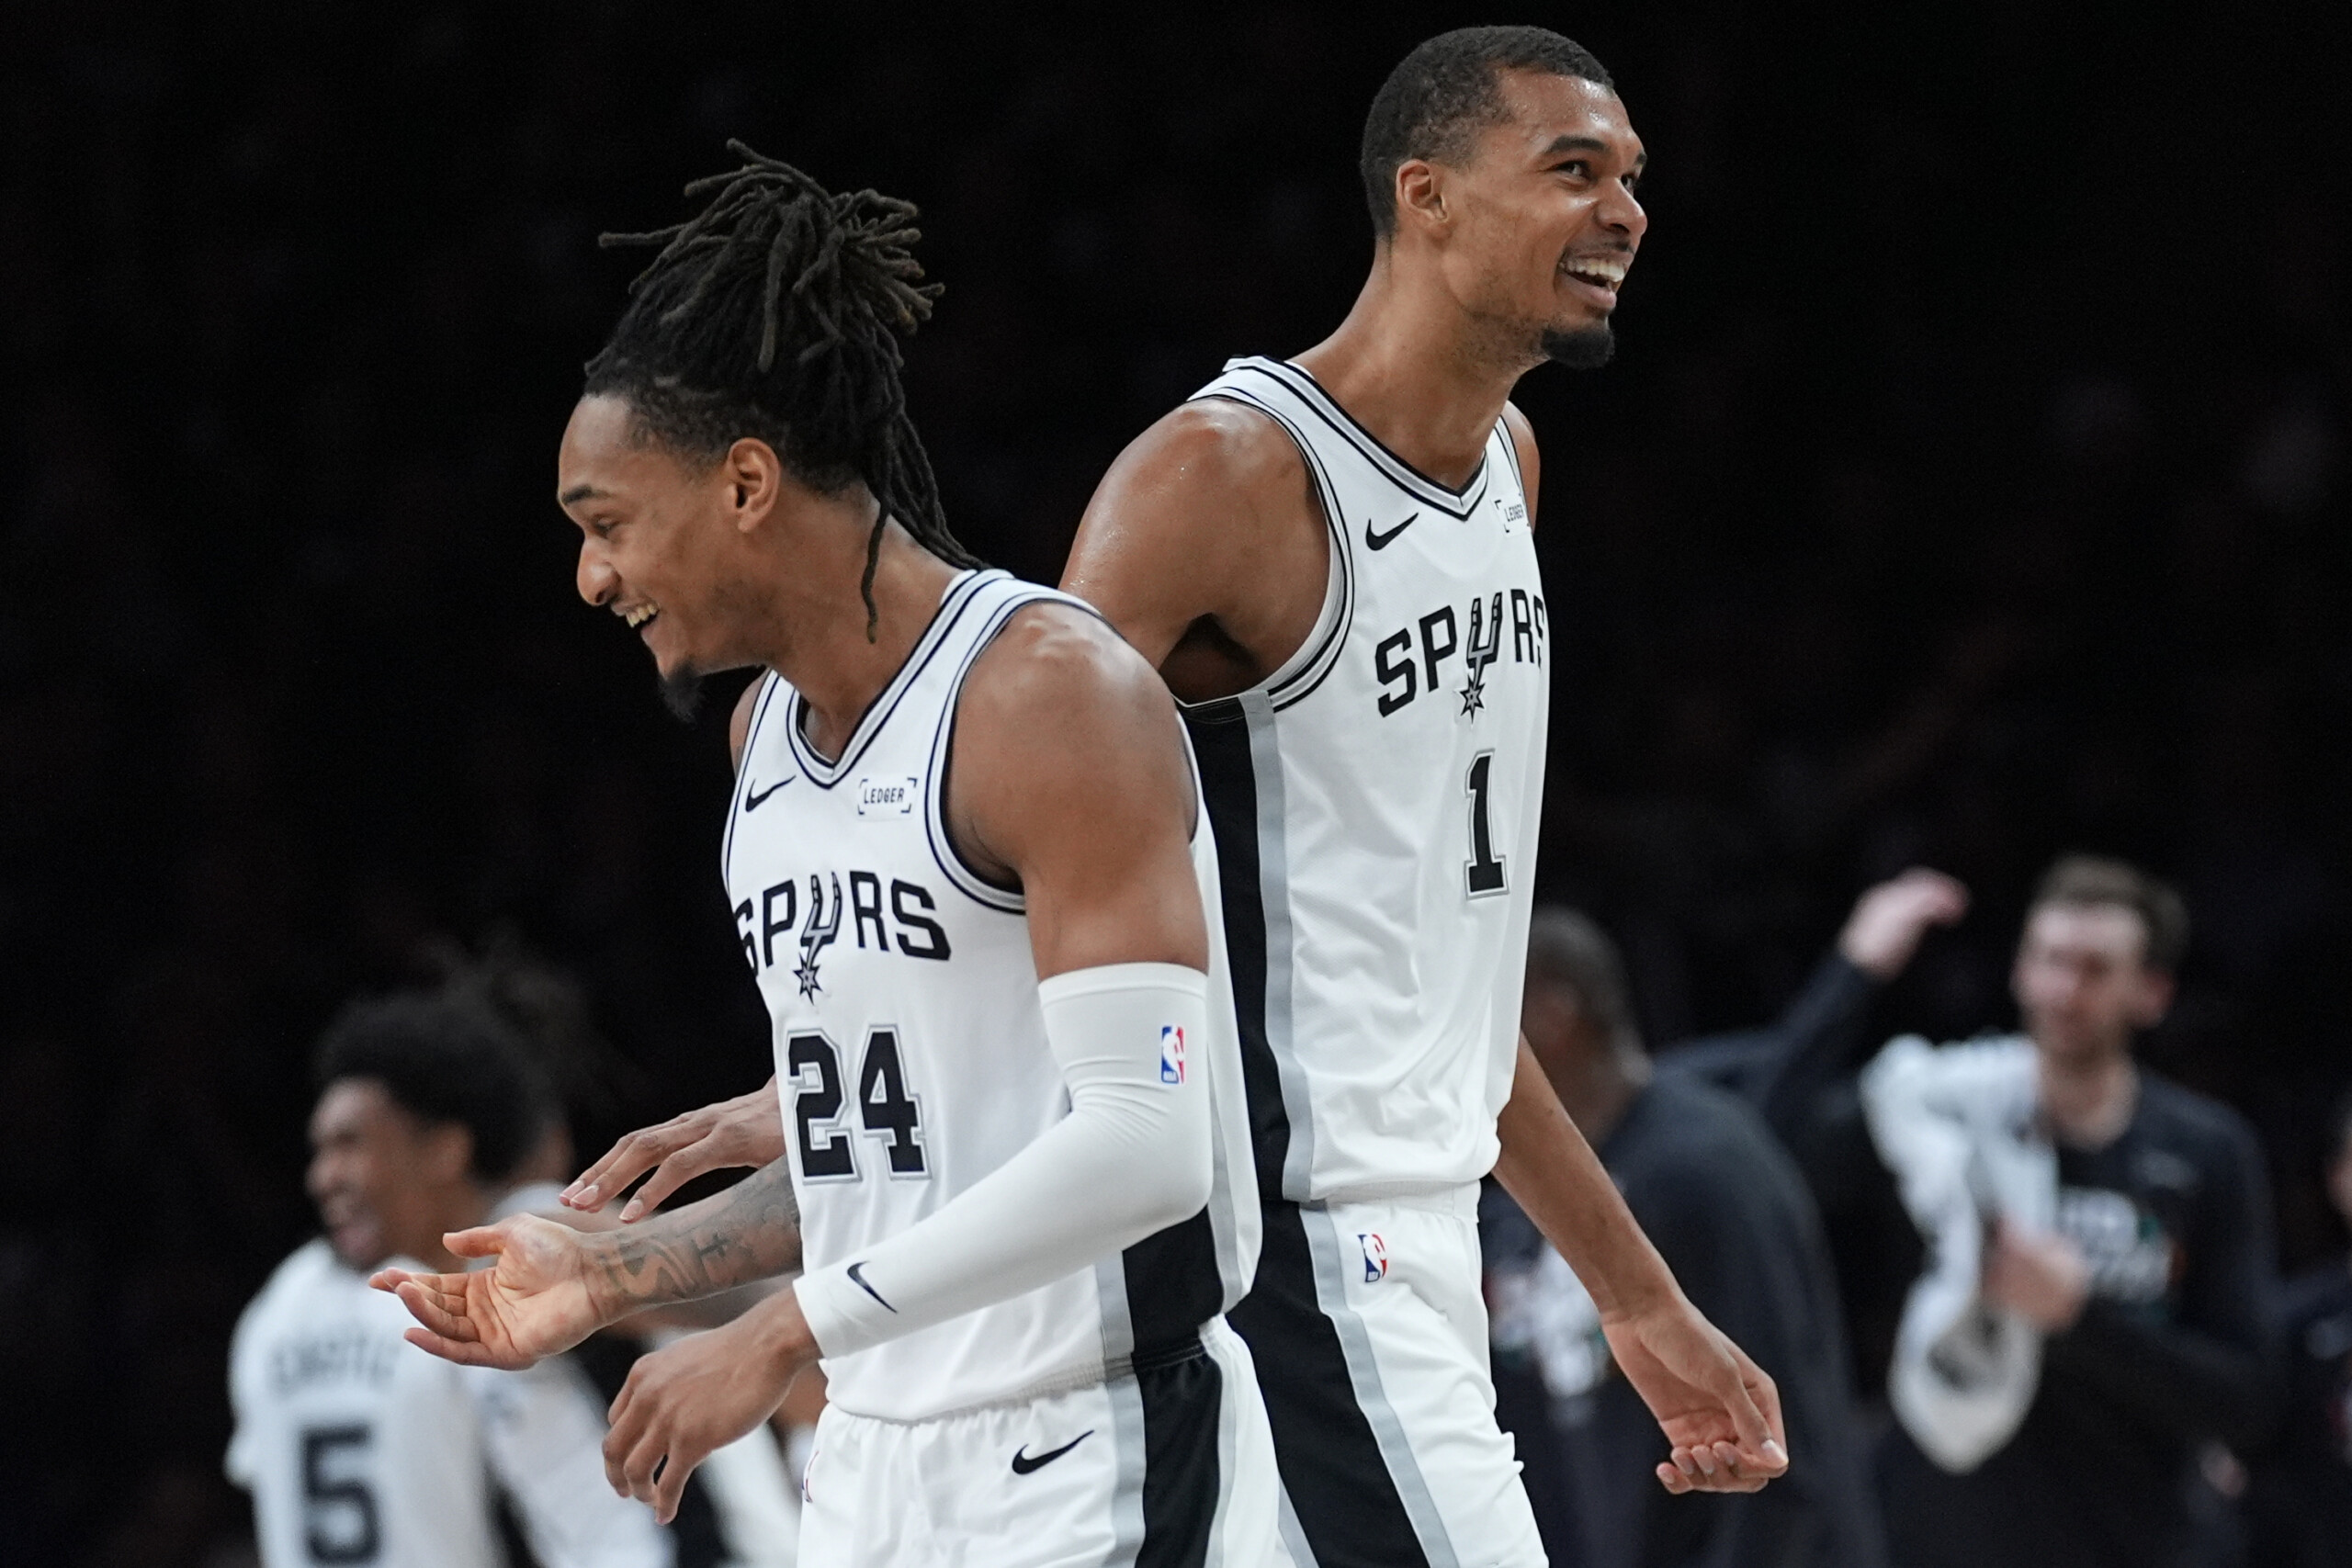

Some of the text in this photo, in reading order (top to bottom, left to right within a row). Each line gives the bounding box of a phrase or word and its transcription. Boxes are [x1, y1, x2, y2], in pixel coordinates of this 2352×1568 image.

[1504, 503, 1524, 523] LEDGER
[864, 787, 905, 804] LEDGER
[1464, 748, 1510, 901] 1
[733, 870, 952, 1005] SPURS
[787, 1023, 933, 1185] 24
[300, 1423, 381, 1565] 5
